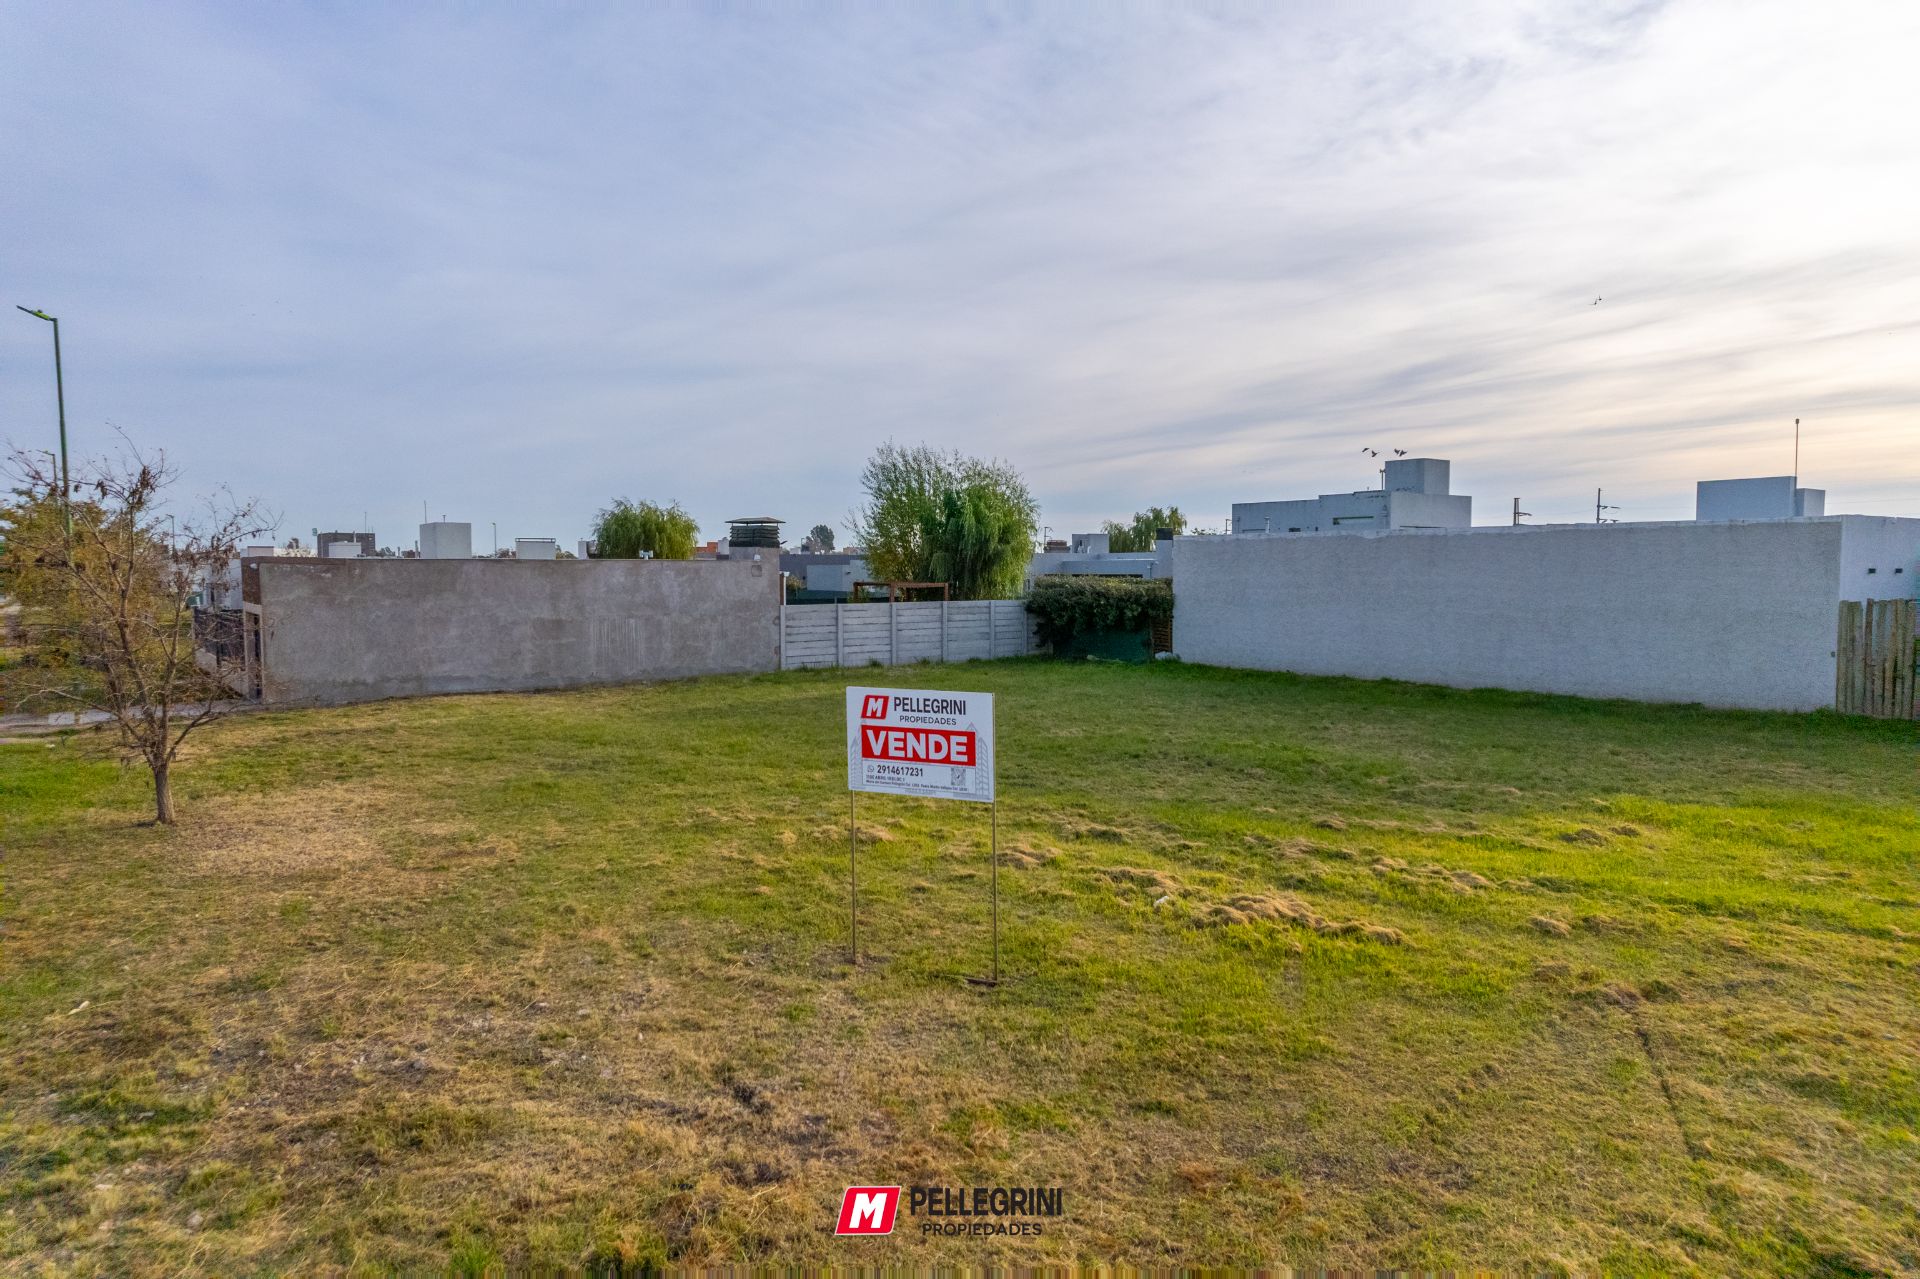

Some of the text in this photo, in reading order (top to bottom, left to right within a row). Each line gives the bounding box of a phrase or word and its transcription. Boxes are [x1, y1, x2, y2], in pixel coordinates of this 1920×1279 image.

[866, 696, 967, 717] M PELLEGRINI
[899, 715, 957, 726] PROPIEDADES
[866, 729, 968, 762] VENDE
[877, 765, 923, 777] 2914617231
